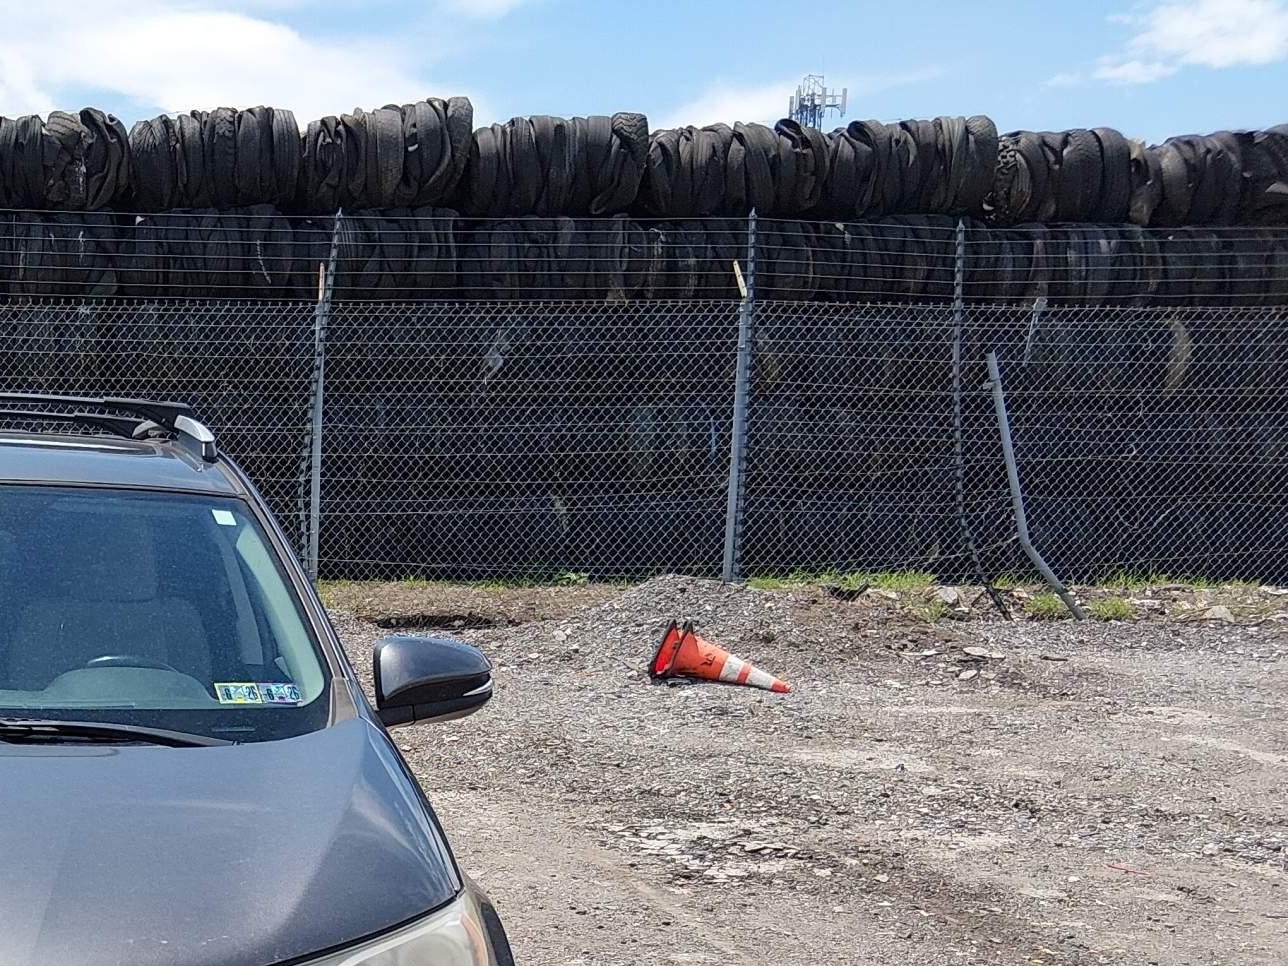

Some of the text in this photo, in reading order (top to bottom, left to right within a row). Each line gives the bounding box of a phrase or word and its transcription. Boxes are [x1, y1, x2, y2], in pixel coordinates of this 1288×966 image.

[244, 685, 259, 701] 26
[266, 686, 300, 701] 6 26
